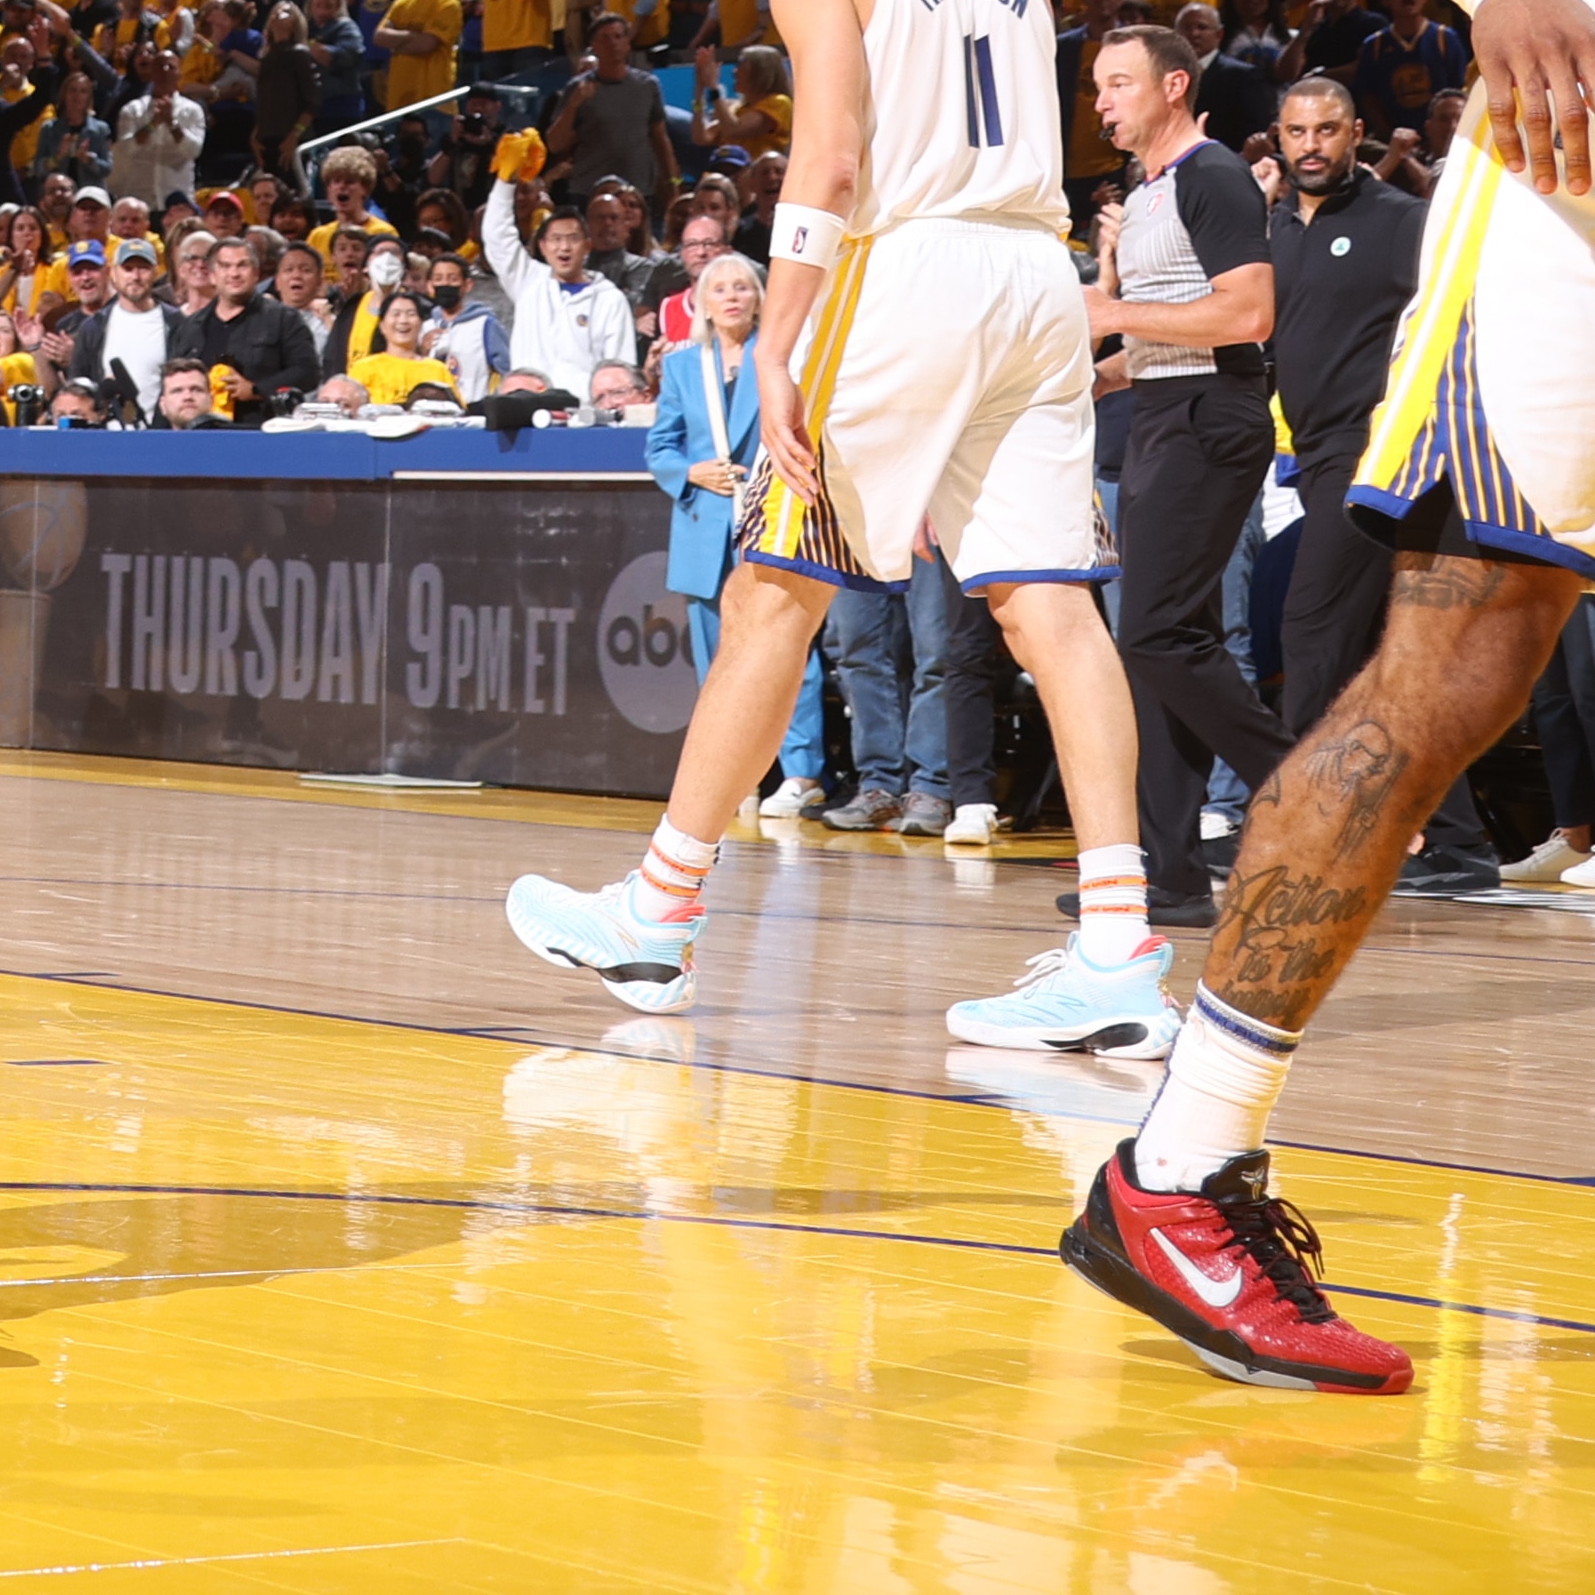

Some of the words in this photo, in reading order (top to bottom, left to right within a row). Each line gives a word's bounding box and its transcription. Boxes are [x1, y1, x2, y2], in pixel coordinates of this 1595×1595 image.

[963, 33, 1005, 150] 11
[101, 553, 388, 706] THURSDAY
[524, 607, 575, 715] ET
[1278, 938, 1336, 984] the
